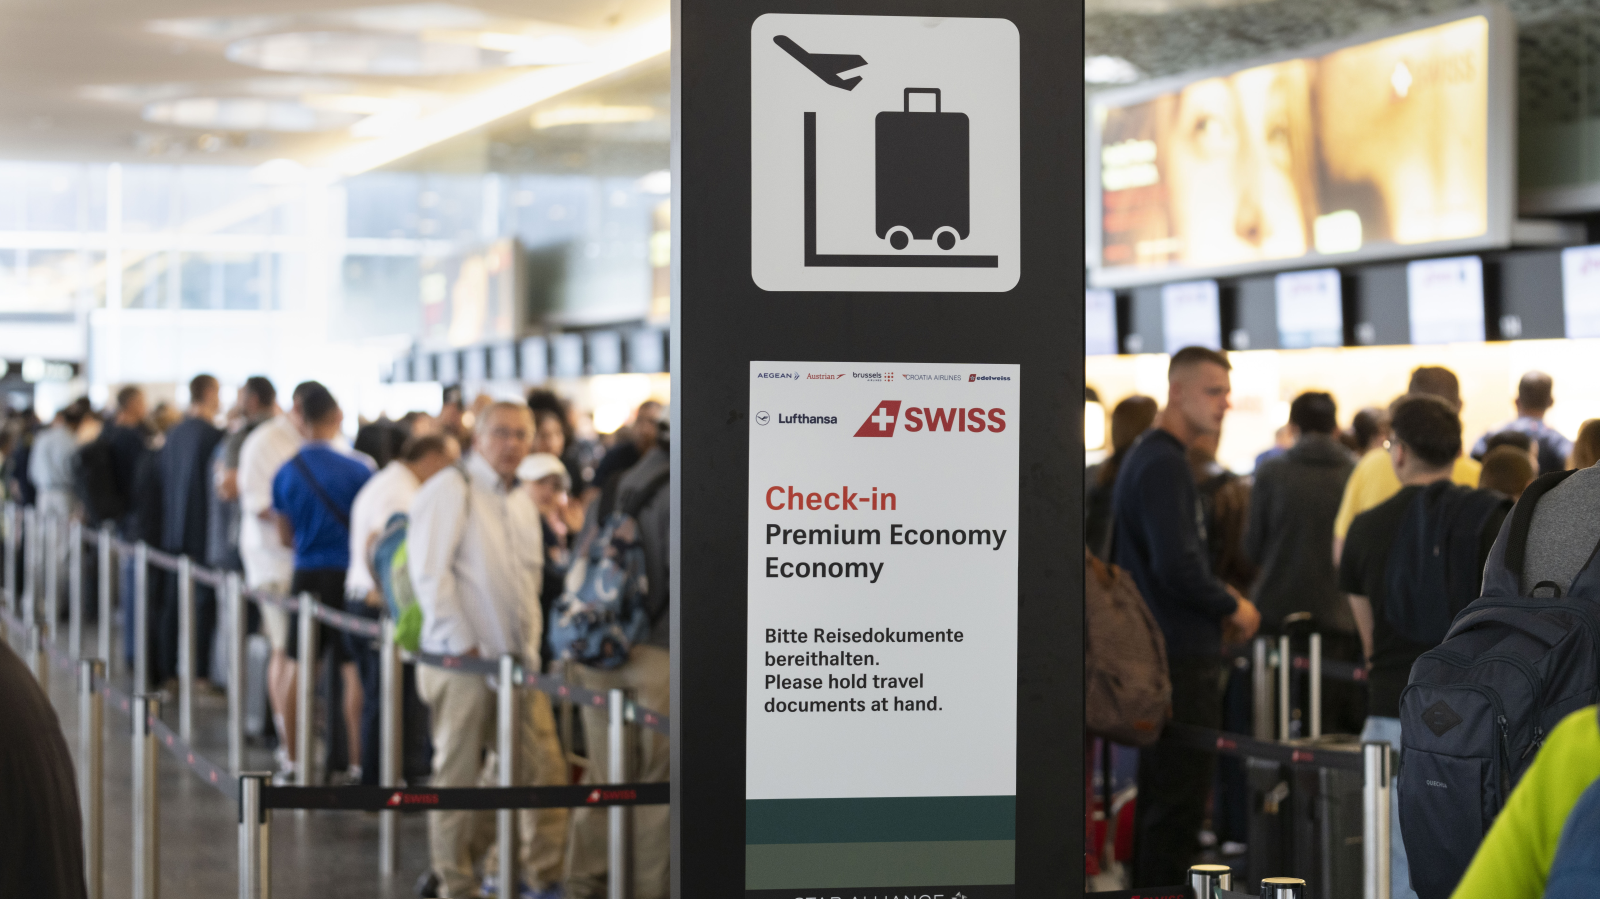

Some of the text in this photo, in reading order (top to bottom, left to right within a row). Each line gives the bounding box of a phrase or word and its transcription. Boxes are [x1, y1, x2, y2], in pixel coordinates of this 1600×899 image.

[806, 372, 835, 380] Austrian
[852, 371, 882, 379] brussels
[778, 413, 838, 425] Lufthansa
[904, 407, 1006, 433] SWISS
[765, 486, 897, 511] Check-in
[766, 524, 1007, 551] Premium Economy
[765, 557, 884, 583] Economy
[765, 628, 964, 643] Bitte Reisedokumente
[765, 651, 880, 667] bereithalten.
[765, 673, 924, 690] Please hold travel
[764, 696, 943, 713] documents at hand.
